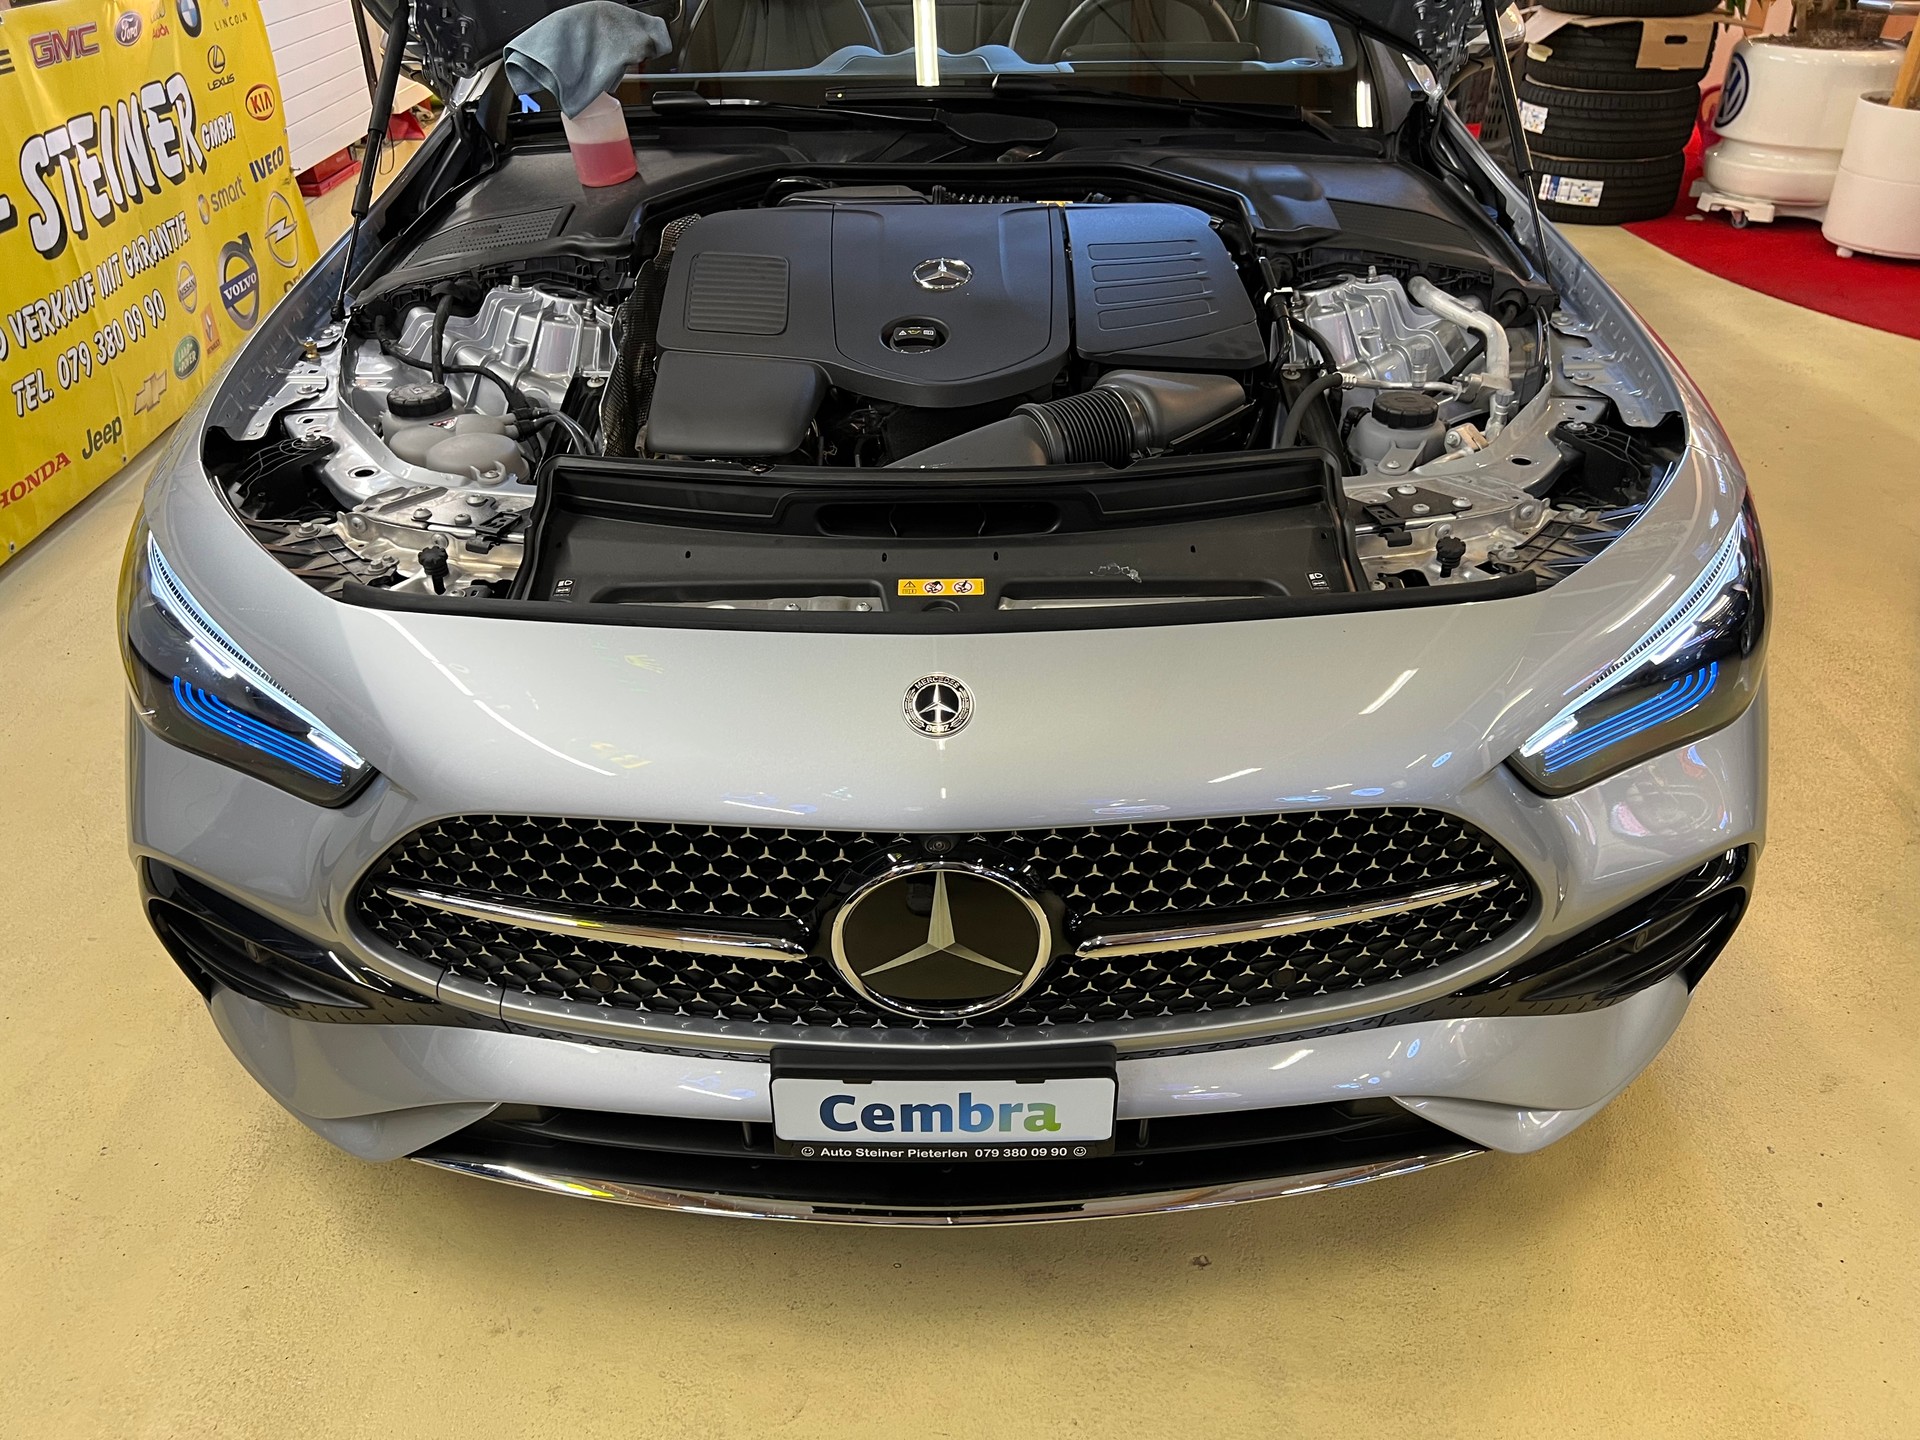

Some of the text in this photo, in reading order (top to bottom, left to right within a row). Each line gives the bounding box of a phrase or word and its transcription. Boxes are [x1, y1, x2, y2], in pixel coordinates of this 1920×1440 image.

[120, 17, 138, 42] Ford
[214, 12, 248, 31] LINCOLN
[28, 21, 100, 69] GMC
[207, 73, 235, 91] LEXUS
[250, 91, 273, 114] KIA
[201, 111, 236, 152] GMBH
[249, 145, 285, 183] IVECO
[210, 173, 246, 212] smart
[7, 271, 96, 350] VERKAUF
[95, 252, 124, 299] MIT
[223, 272, 257, 301] VOLVO
[11, 368, 54, 418] TEL.
[57, 341, 93, 390] 079
[93, 318, 126, 365] 380
[123, 304, 146, 343] 09
[143, 288, 167, 329] 90
[81, 416, 123, 460] Jeep
[0, 452, 72, 509] HONDA
[914, 675, 960, 689] MERCEDES
[819, 1092, 1062, 1133] Cembra
[820, 1147, 1068, 1158] Auto Steiner Pieterlen 079 380 09 90
